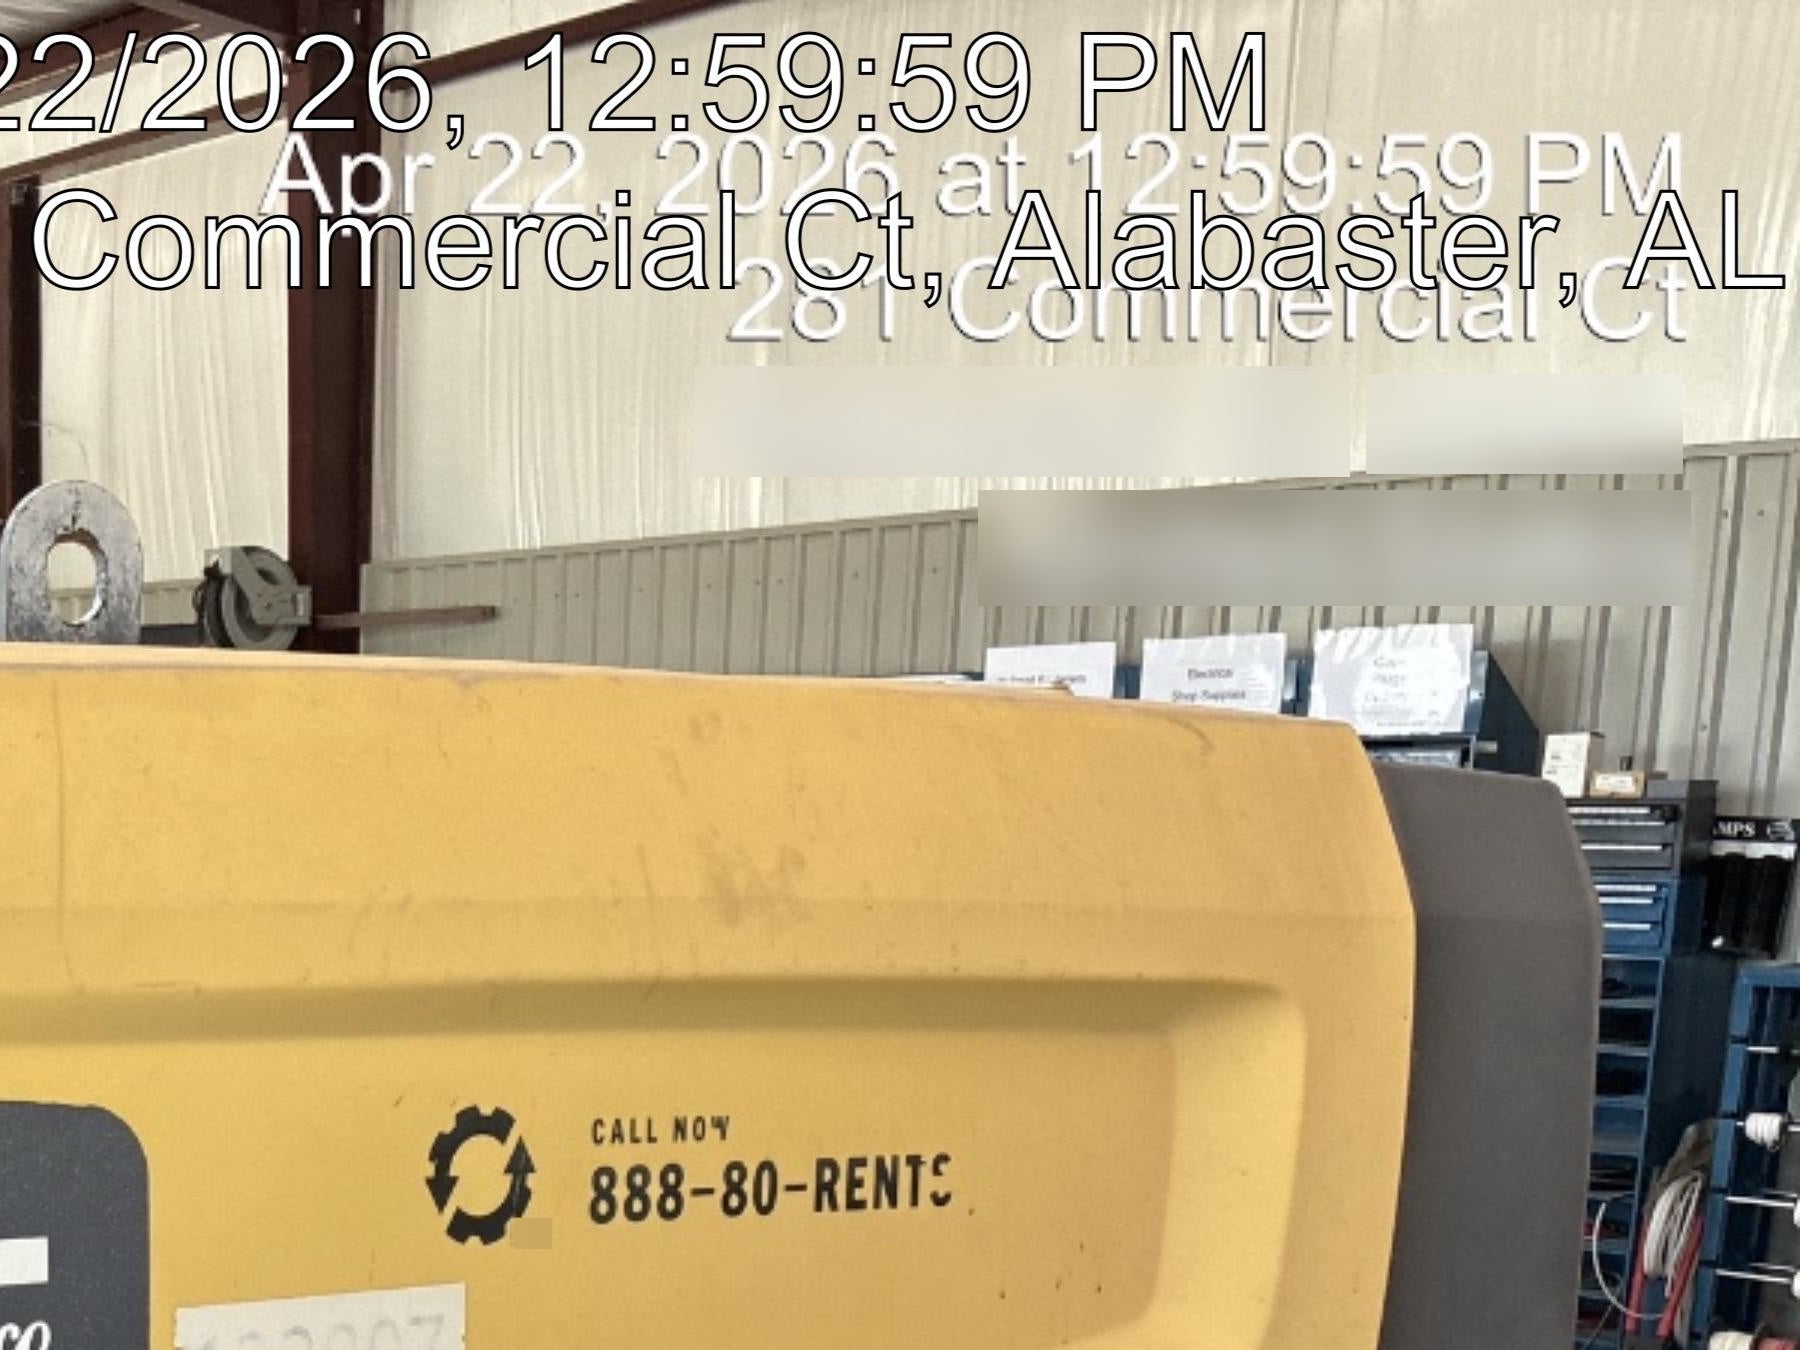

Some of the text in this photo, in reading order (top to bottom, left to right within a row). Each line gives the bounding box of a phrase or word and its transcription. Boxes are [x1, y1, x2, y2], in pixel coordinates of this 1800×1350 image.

[591, 1114, 732, 1146] CALL NOW
[588, 1151, 954, 1225] 888-80-RENTS
